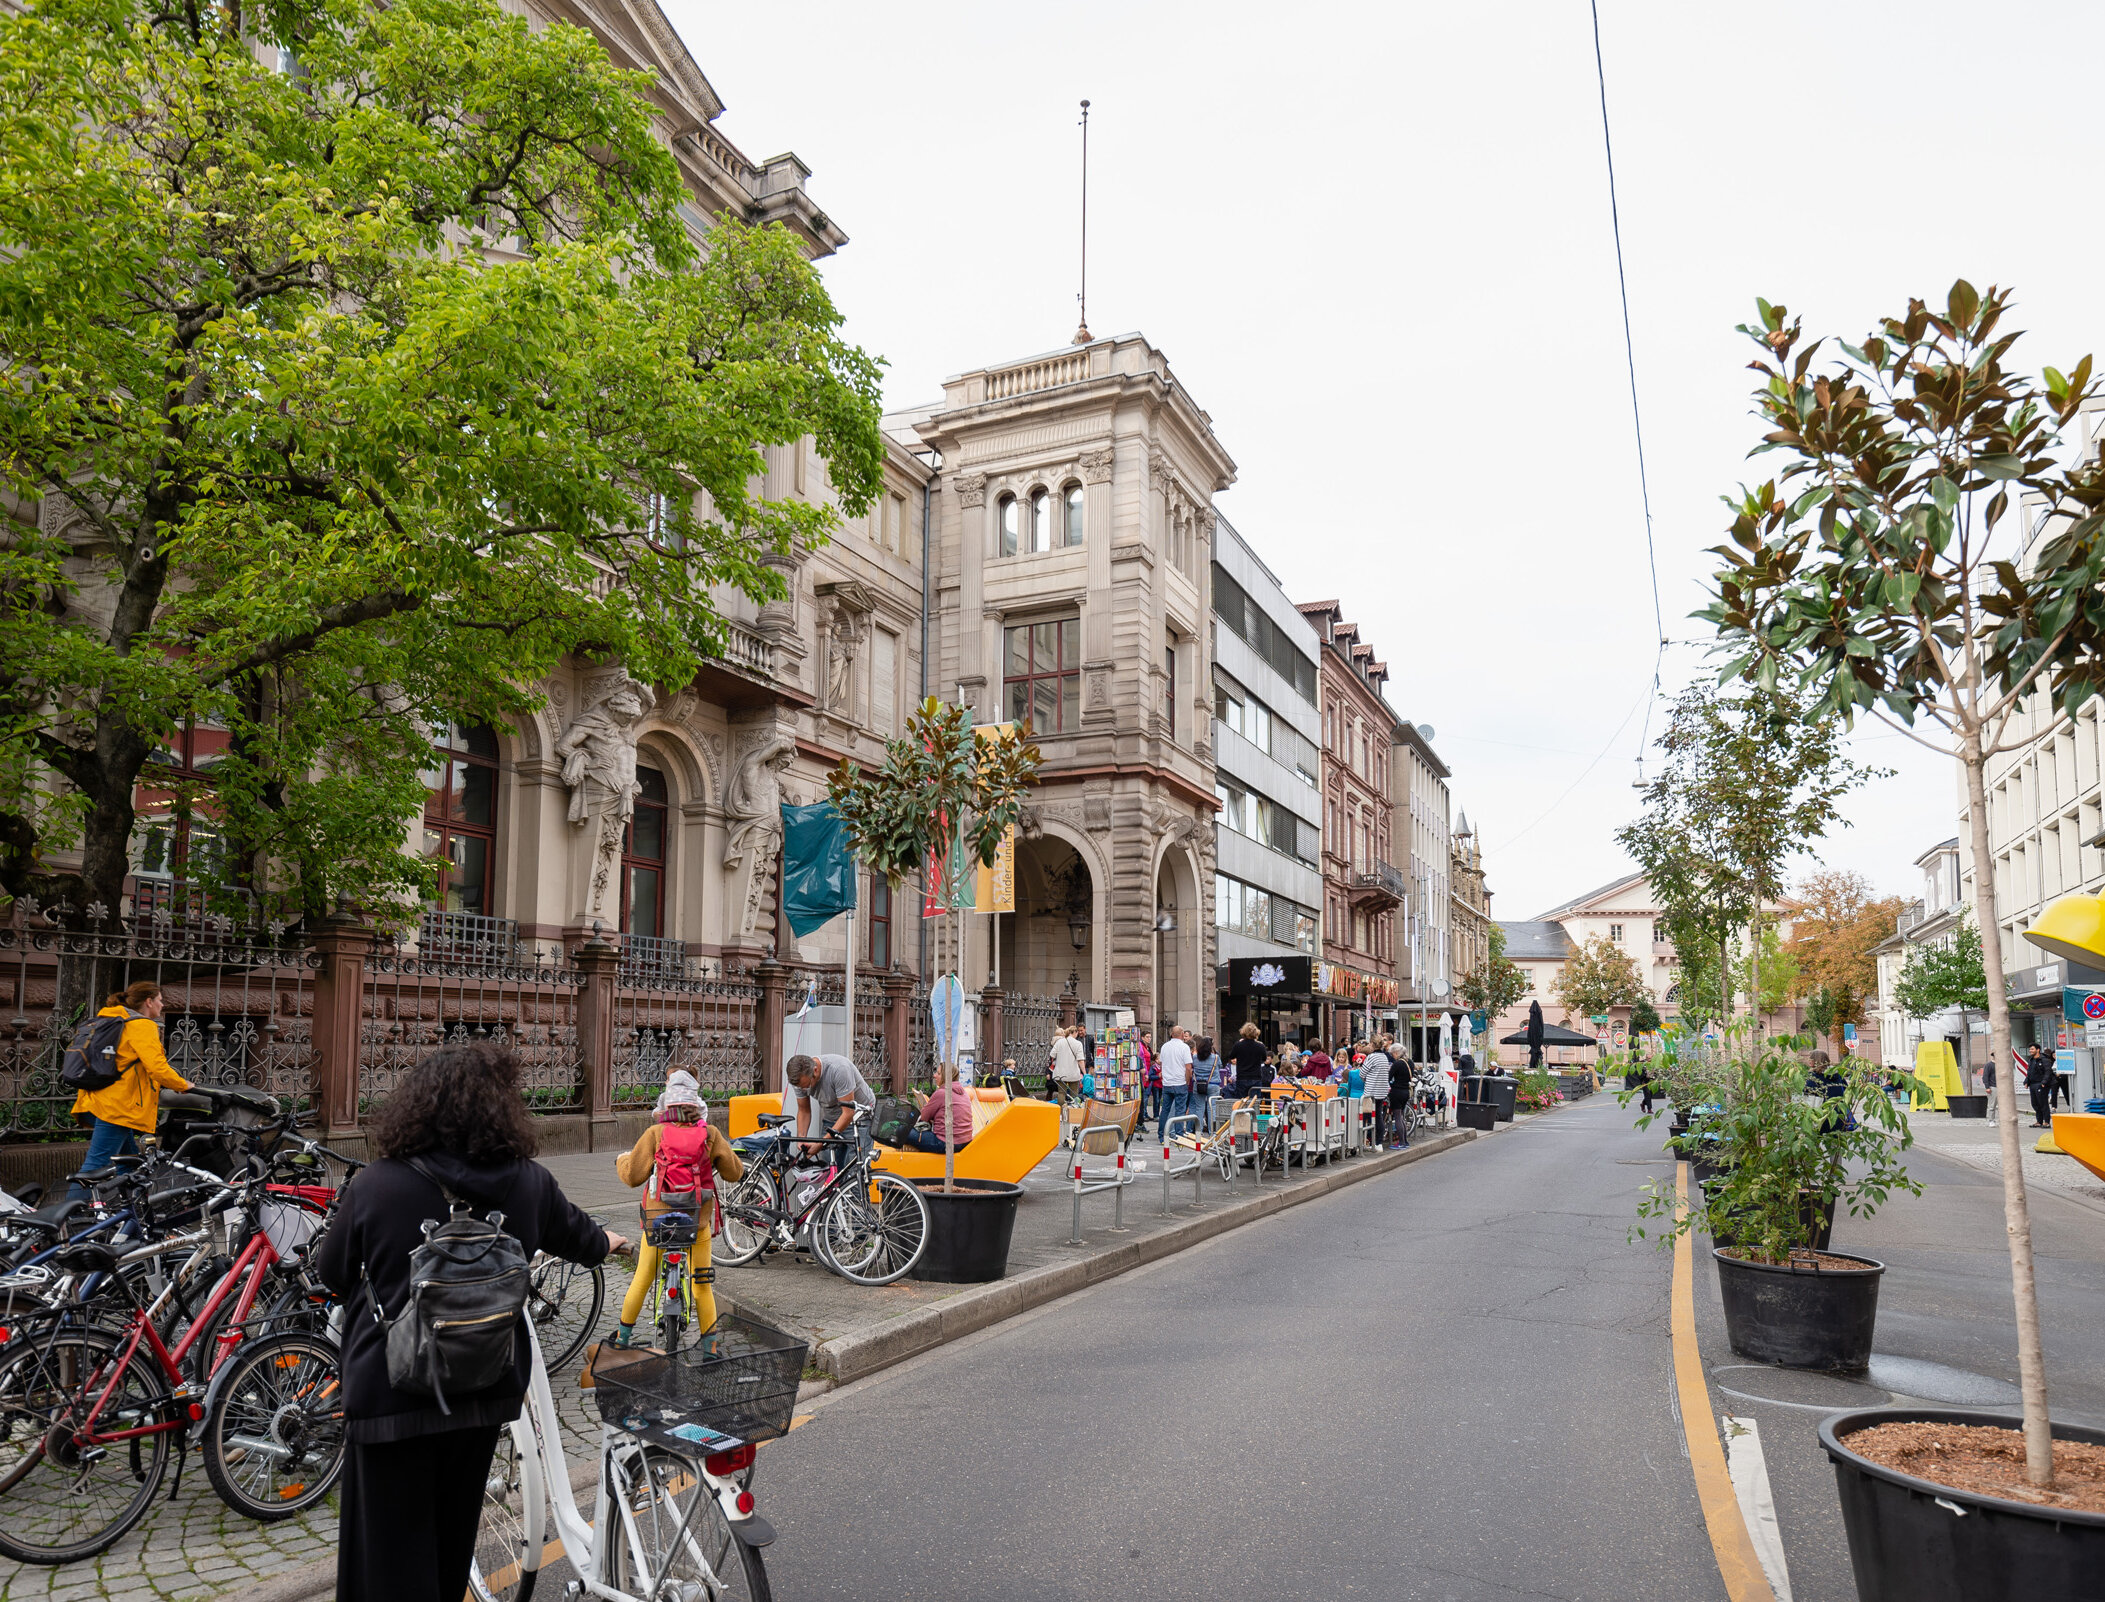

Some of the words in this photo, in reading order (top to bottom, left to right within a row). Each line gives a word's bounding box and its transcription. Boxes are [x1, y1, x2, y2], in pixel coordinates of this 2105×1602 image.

[1003, 841, 1012, 862] und
[1002, 865, 1011, 903] Kinder-
[1329, 965, 1361, 999] ANTEP
